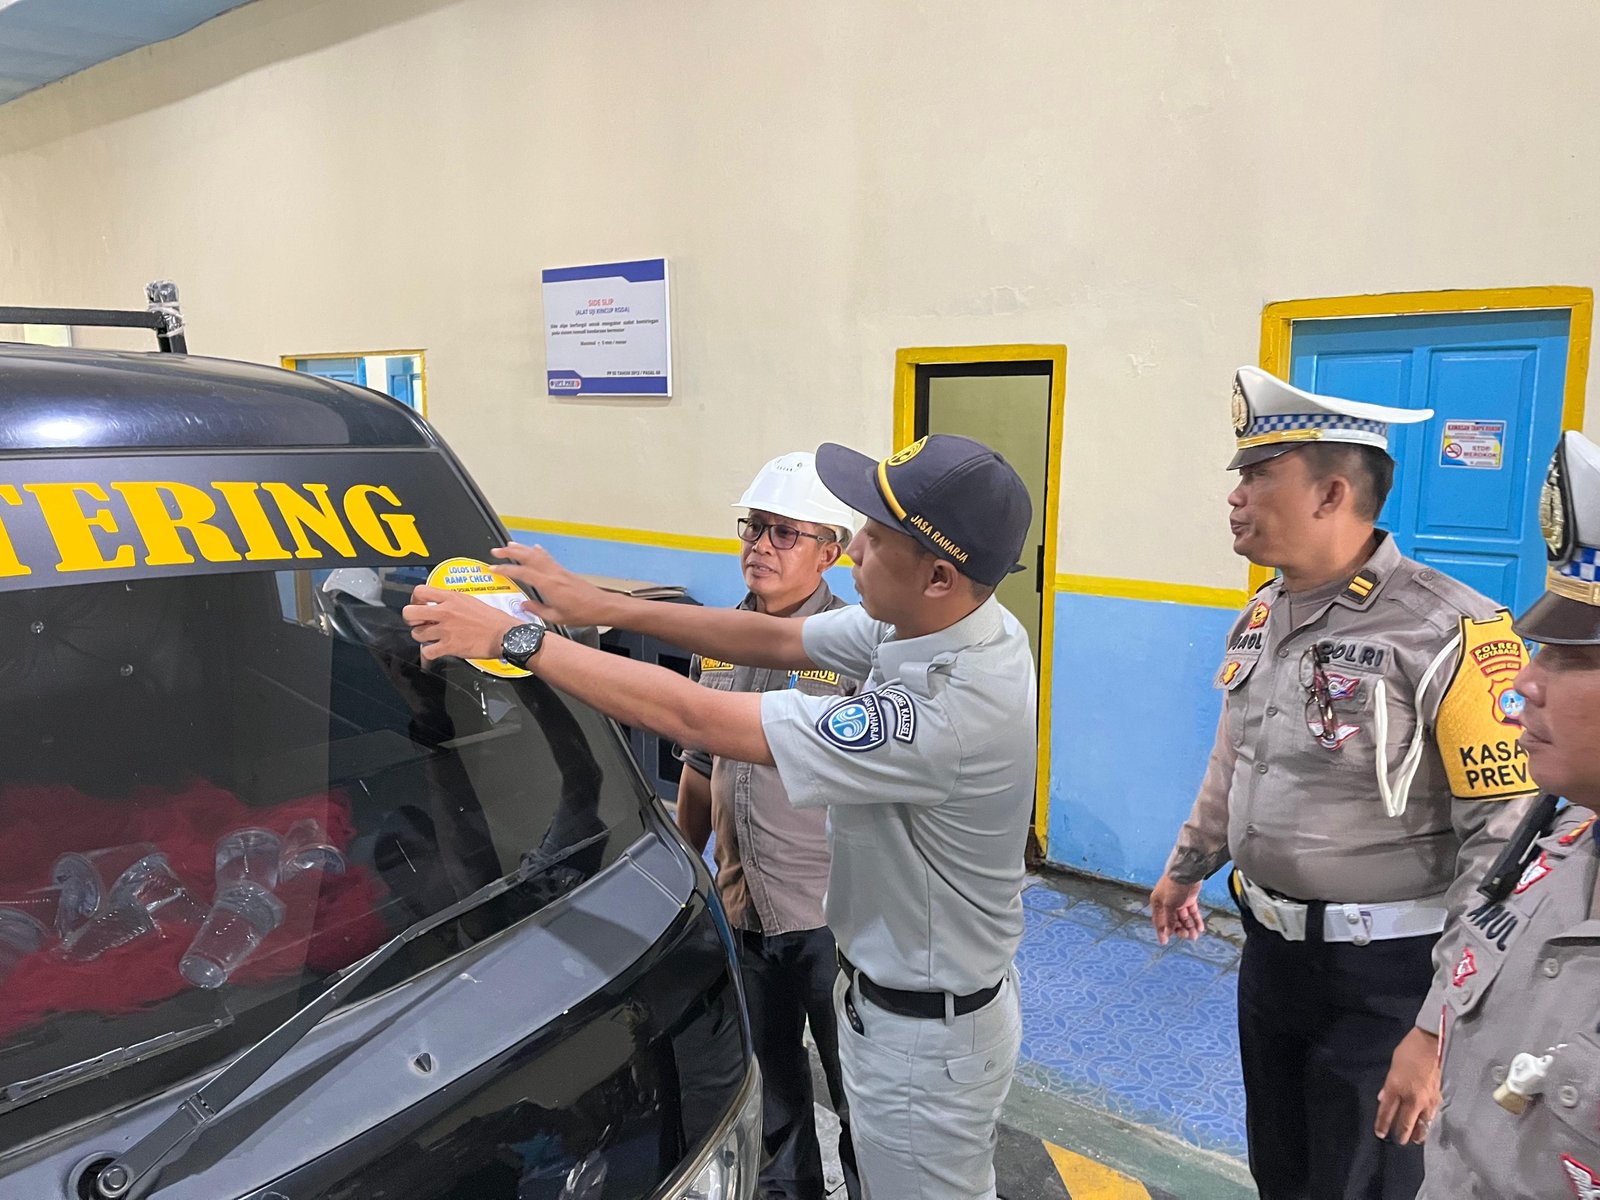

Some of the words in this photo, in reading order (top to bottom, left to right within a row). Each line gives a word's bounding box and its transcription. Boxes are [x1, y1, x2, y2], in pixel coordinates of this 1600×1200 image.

[910, 514, 933, 536] JASA
[930, 530, 969, 563] RAHARJA
[445, 576, 467, 584] RAMP
[1318, 641, 1385, 667] POLRI
[1474, 642, 1518, 657] POLRES
[866, 707, 879, 742] RAHARJA
[898, 708, 911, 737] KALSEL
[1466, 763, 1527, 789] PREV
